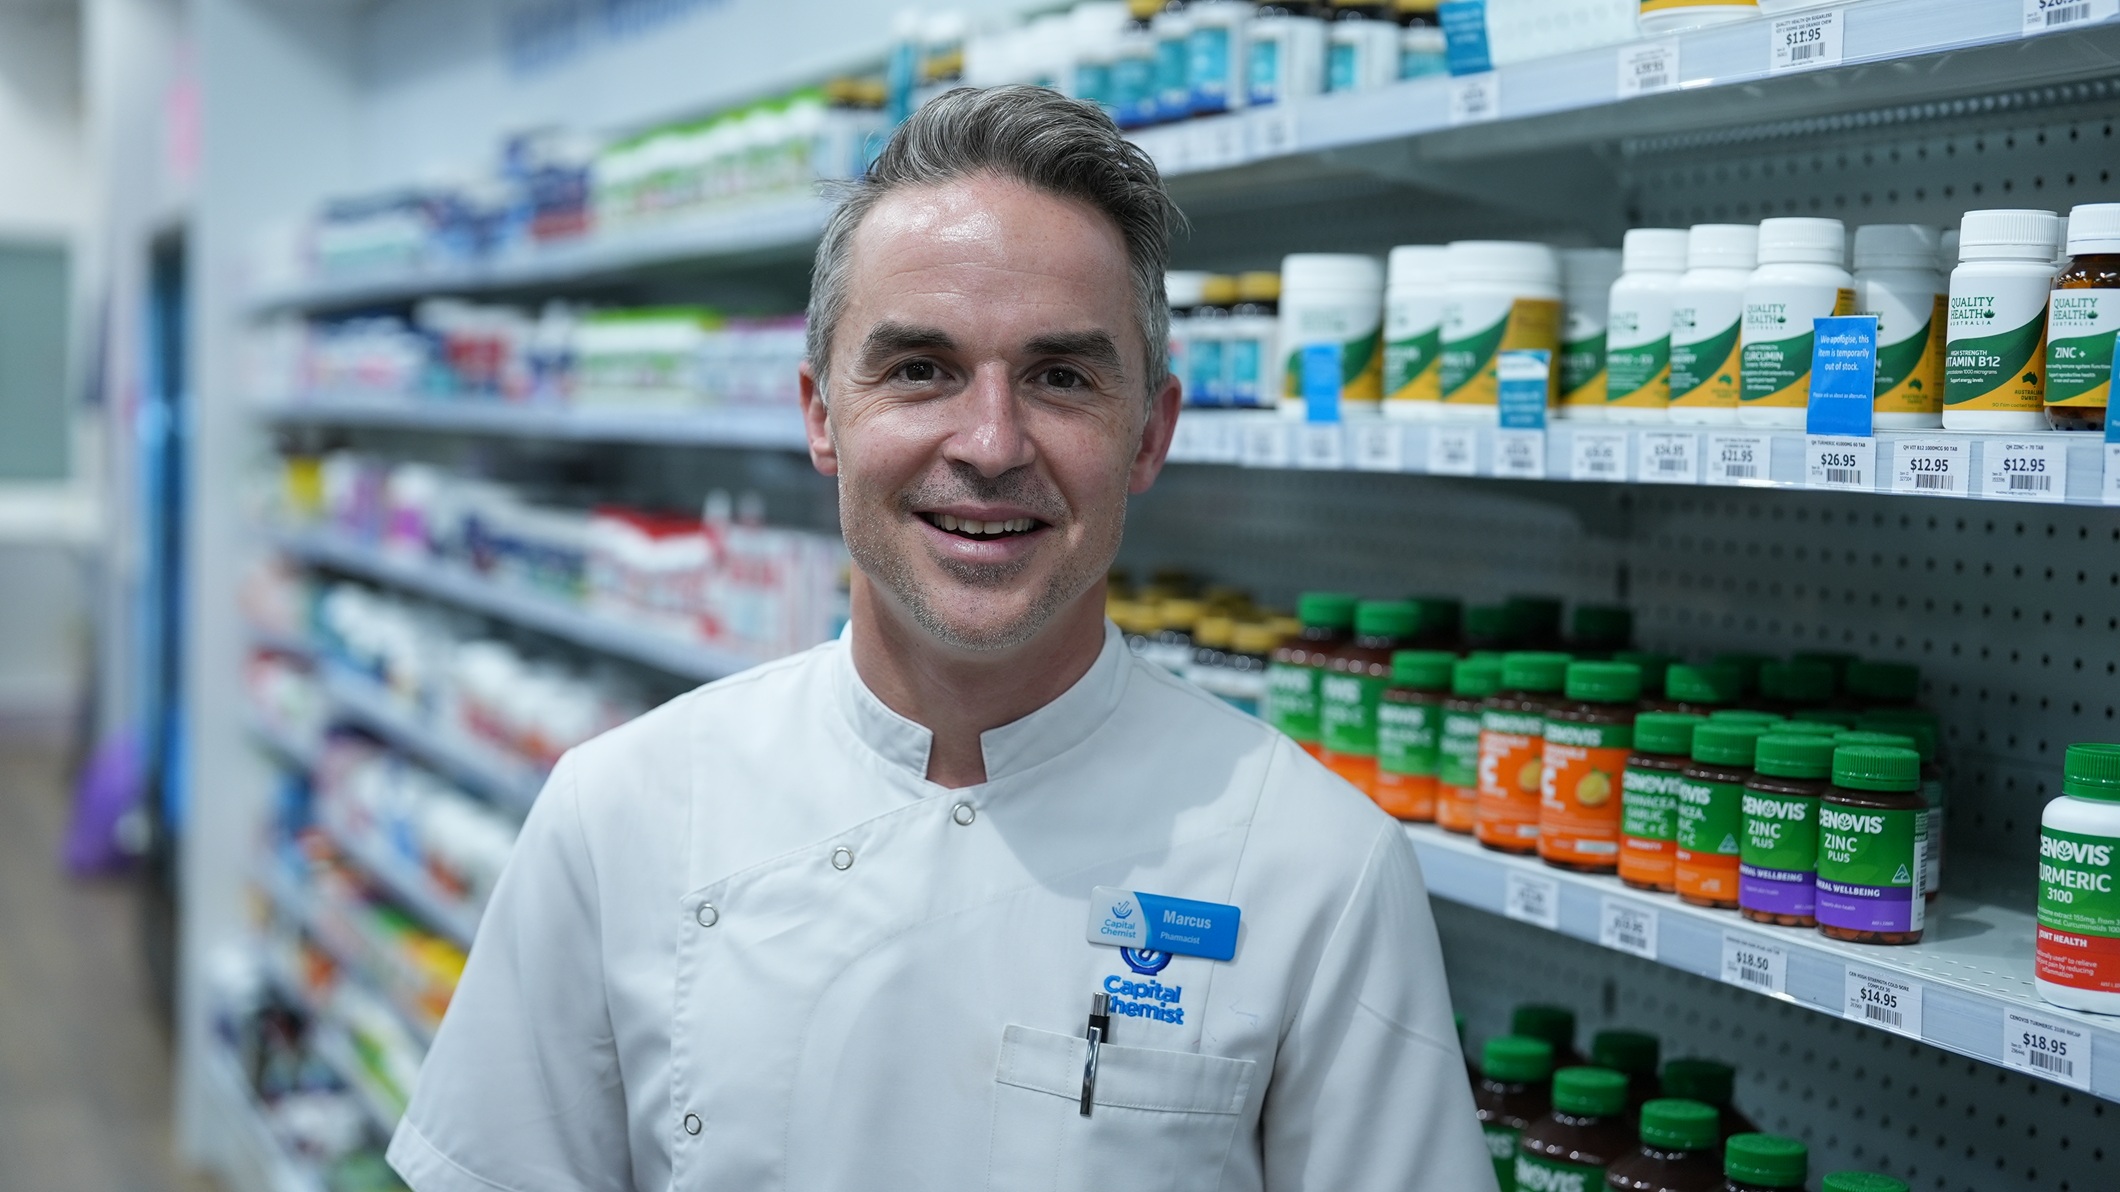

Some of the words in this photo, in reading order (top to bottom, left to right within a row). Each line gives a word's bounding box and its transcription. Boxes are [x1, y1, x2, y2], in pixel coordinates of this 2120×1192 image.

[1786, 27, 1821, 48] $11.95
[1951, 296, 1995, 308] QUALITY
[2054, 298, 2098, 309] QUALITY
[1951, 309, 1983, 320] HEALTH
[2054, 310, 2087, 320] HEALTH
[1820, 334, 1830, 344] We
[1830, 334, 1857, 345] apologise,
[1858, 334, 1869, 344] this
[1818, 348, 1830, 357] item
[1831, 348, 1835, 357] is
[1836, 348, 1870, 359] temporarily
[2055, 347, 2077, 358] ZINC
[1825, 362, 1834, 370] out
[1835, 362, 1841, 370] of
[1842, 362, 1859, 370] stock.
[1978, 356, 2000, 367] B12
[1722, 449, 1753, 463] $21.95
[1821, 452, 1856, 468] $26.95
[1910, 457, 1949, 473] $12.95
[2004, 457, 2046, 474] $12.95
[1742, 794, 1806, 821] CENOVIS
[1820, 808, 1882, 834] CENOVIS
[1748, 819, 1781, 839] ZINC
[1752, 836, 1774, 849] PLUS
[1824, 833, 1857, 852] ZINC
[1828, 850, 1850, 863] PLUS
[1757, 868, 1803, 882] WELLBEING
[1833, 884, 1880, 897] WELLBEING
[2047, 887, 2073, 904] 3100
[1104, 919, 1136, 930] Capital
[1163, 910, 1212, 929] Marcus
[2054, 911, 2072, 920] extract
[2098, 916, 2114, 924] from
[2063, 919, 2107, 932] Curcuminoids
[1100, 927, 1136, 939] Chemist
[1160, 931, 1200, 945] Pharmacist
[2054, 934, 2087, 948] HEALTH
[1737, 950, 1769, 970] $18.50
[2076, 959, 2097, 968] relieve
[2059, 962, 2065, 970] by
[2066, 966, 2094, 976] reducing
[1868, 976, 1887, 986] STRENGTH
[1868, 982, 1885, 992] COMPLEX
[1104, 975, 1182, 1004] Capital
[1860, 987, 1897, 1008] $14.95
[2009, 1014, 2029, 1024] CENOVIS
[2030, 1019, 2053, 1031] TURMERIC
[2023, 1030, 2067, 1056] $18.95
